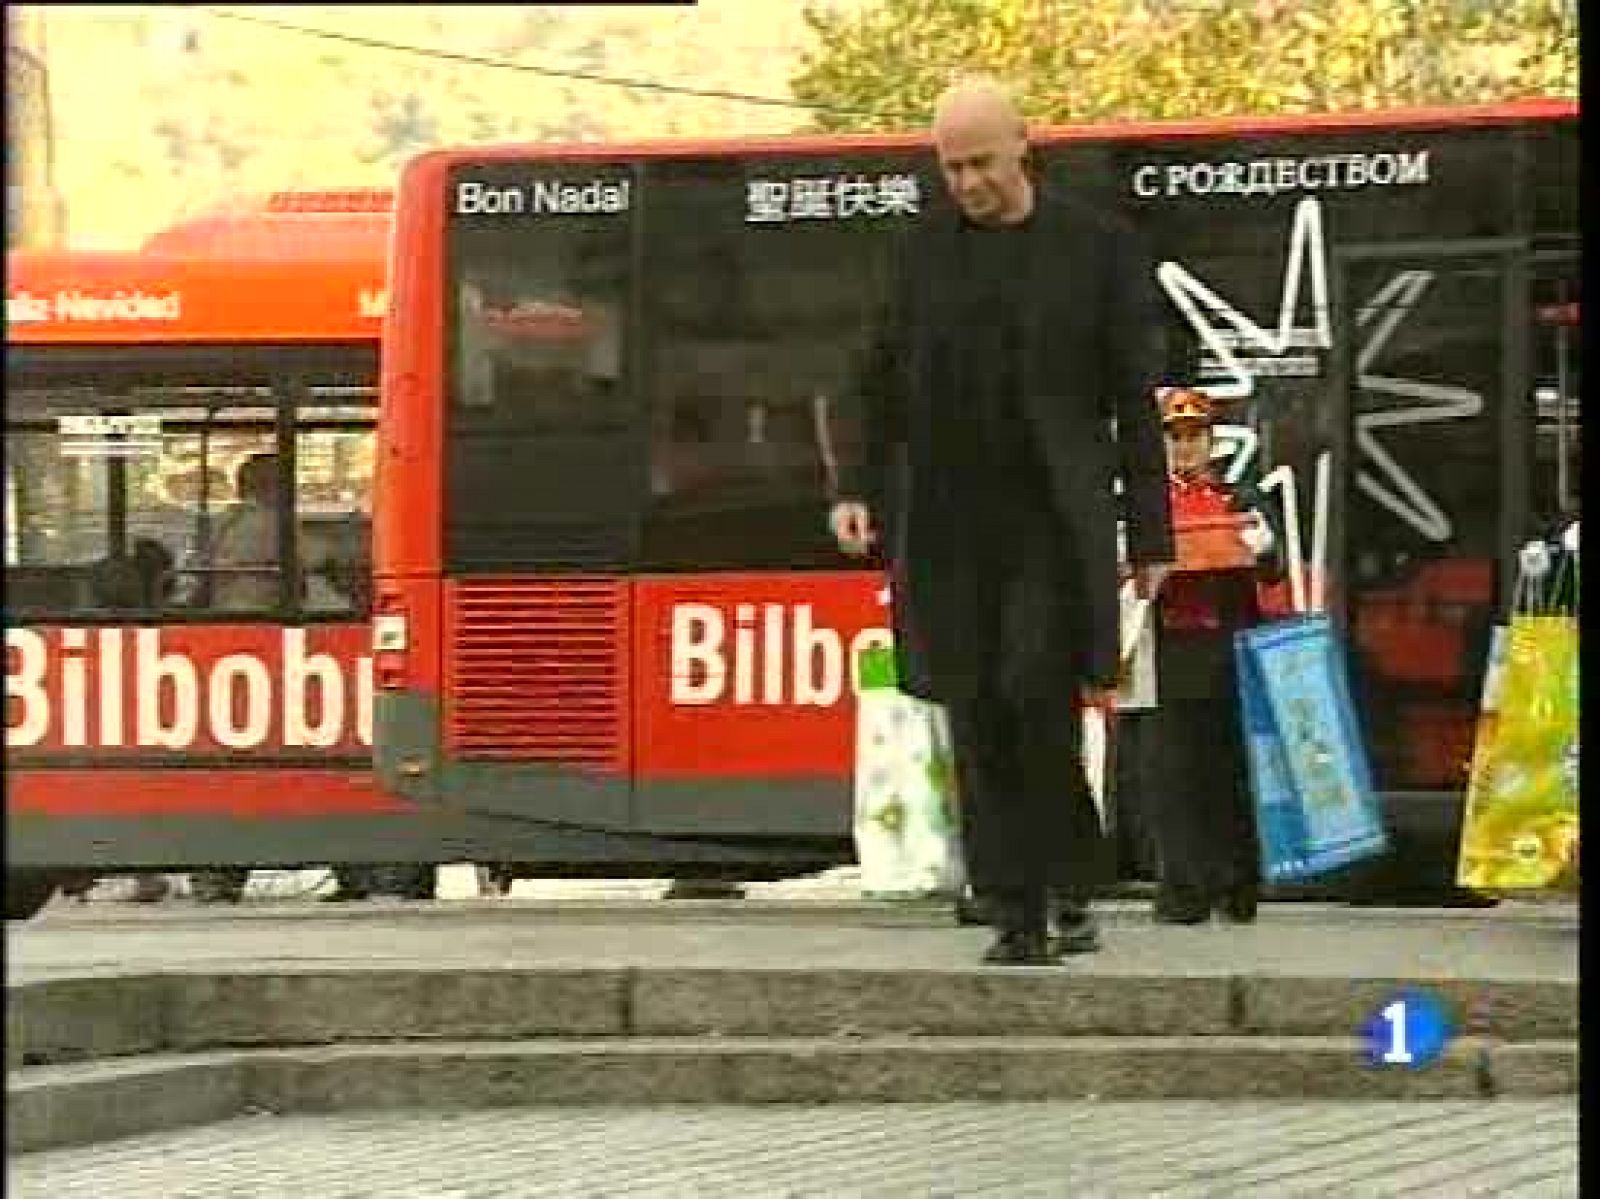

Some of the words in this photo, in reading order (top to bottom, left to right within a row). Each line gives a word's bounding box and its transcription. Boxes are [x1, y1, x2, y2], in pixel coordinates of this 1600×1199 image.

[1165, 150, 1430, 196] РОЖДЕСТВОМ
[458, 182, 524, 213] Bon
[534, 180, 629, 213] Nadal
